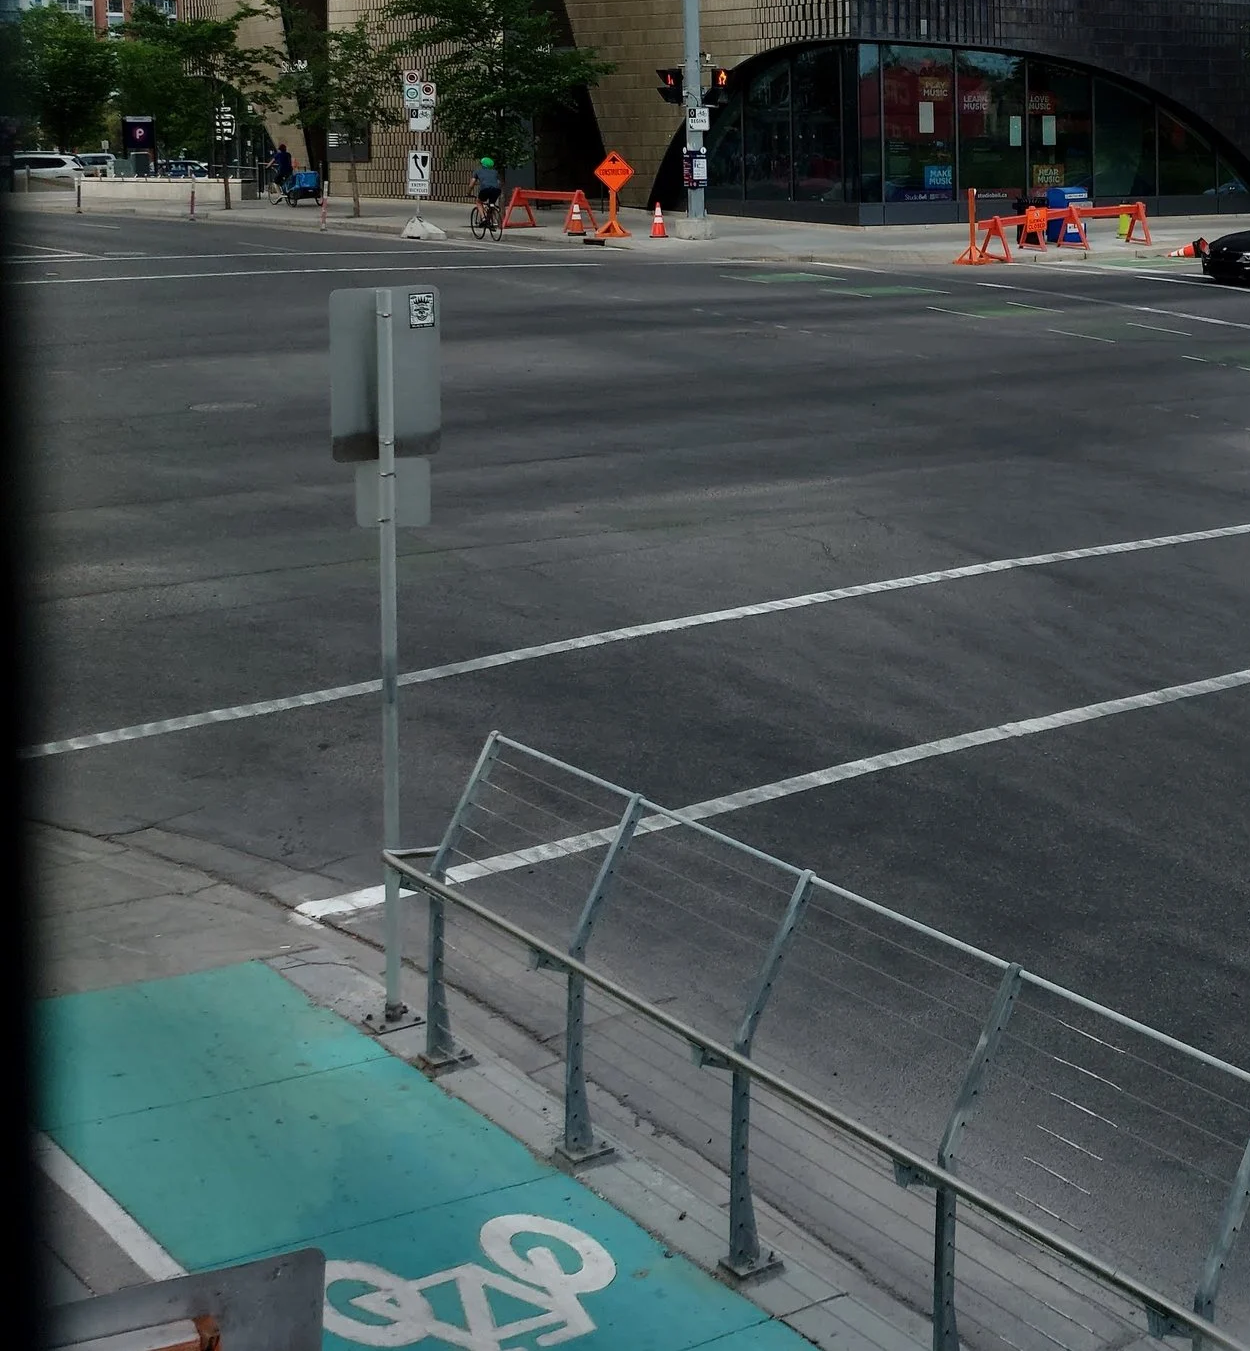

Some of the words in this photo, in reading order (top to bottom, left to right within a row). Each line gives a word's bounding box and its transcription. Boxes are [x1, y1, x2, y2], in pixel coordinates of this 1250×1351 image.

[925, 81, 946, 89] PLAY
[923, 89, 949, 97] MUSIC
[1030, 95, 1049, 103] LOVE
[136, 128, 145, 139] P
[1038, 168, 1059, 176] HEAR
[929, 177, 952, 185] MUSIC
